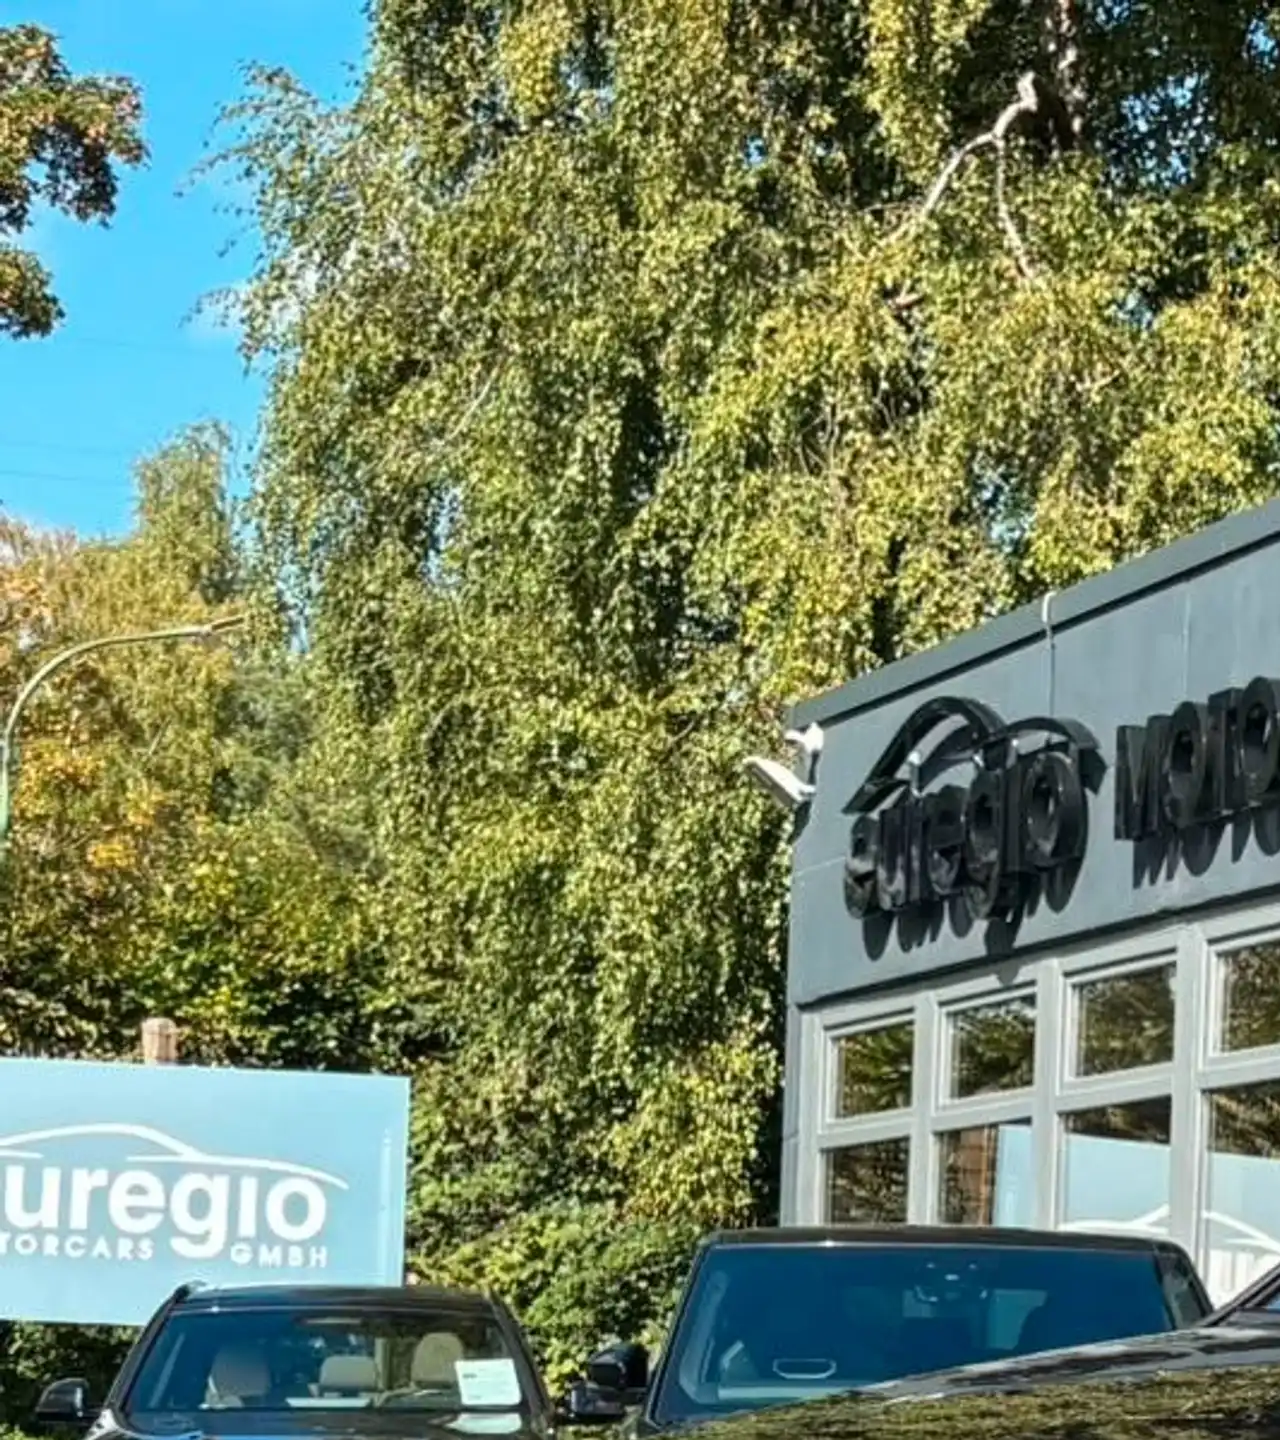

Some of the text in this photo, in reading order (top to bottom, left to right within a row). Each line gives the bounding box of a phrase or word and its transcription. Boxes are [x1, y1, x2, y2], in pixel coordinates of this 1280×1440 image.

[3, 1163, 327, 1259] uregio
[0, 1230, 328, 1269] TORCARS GMBH
